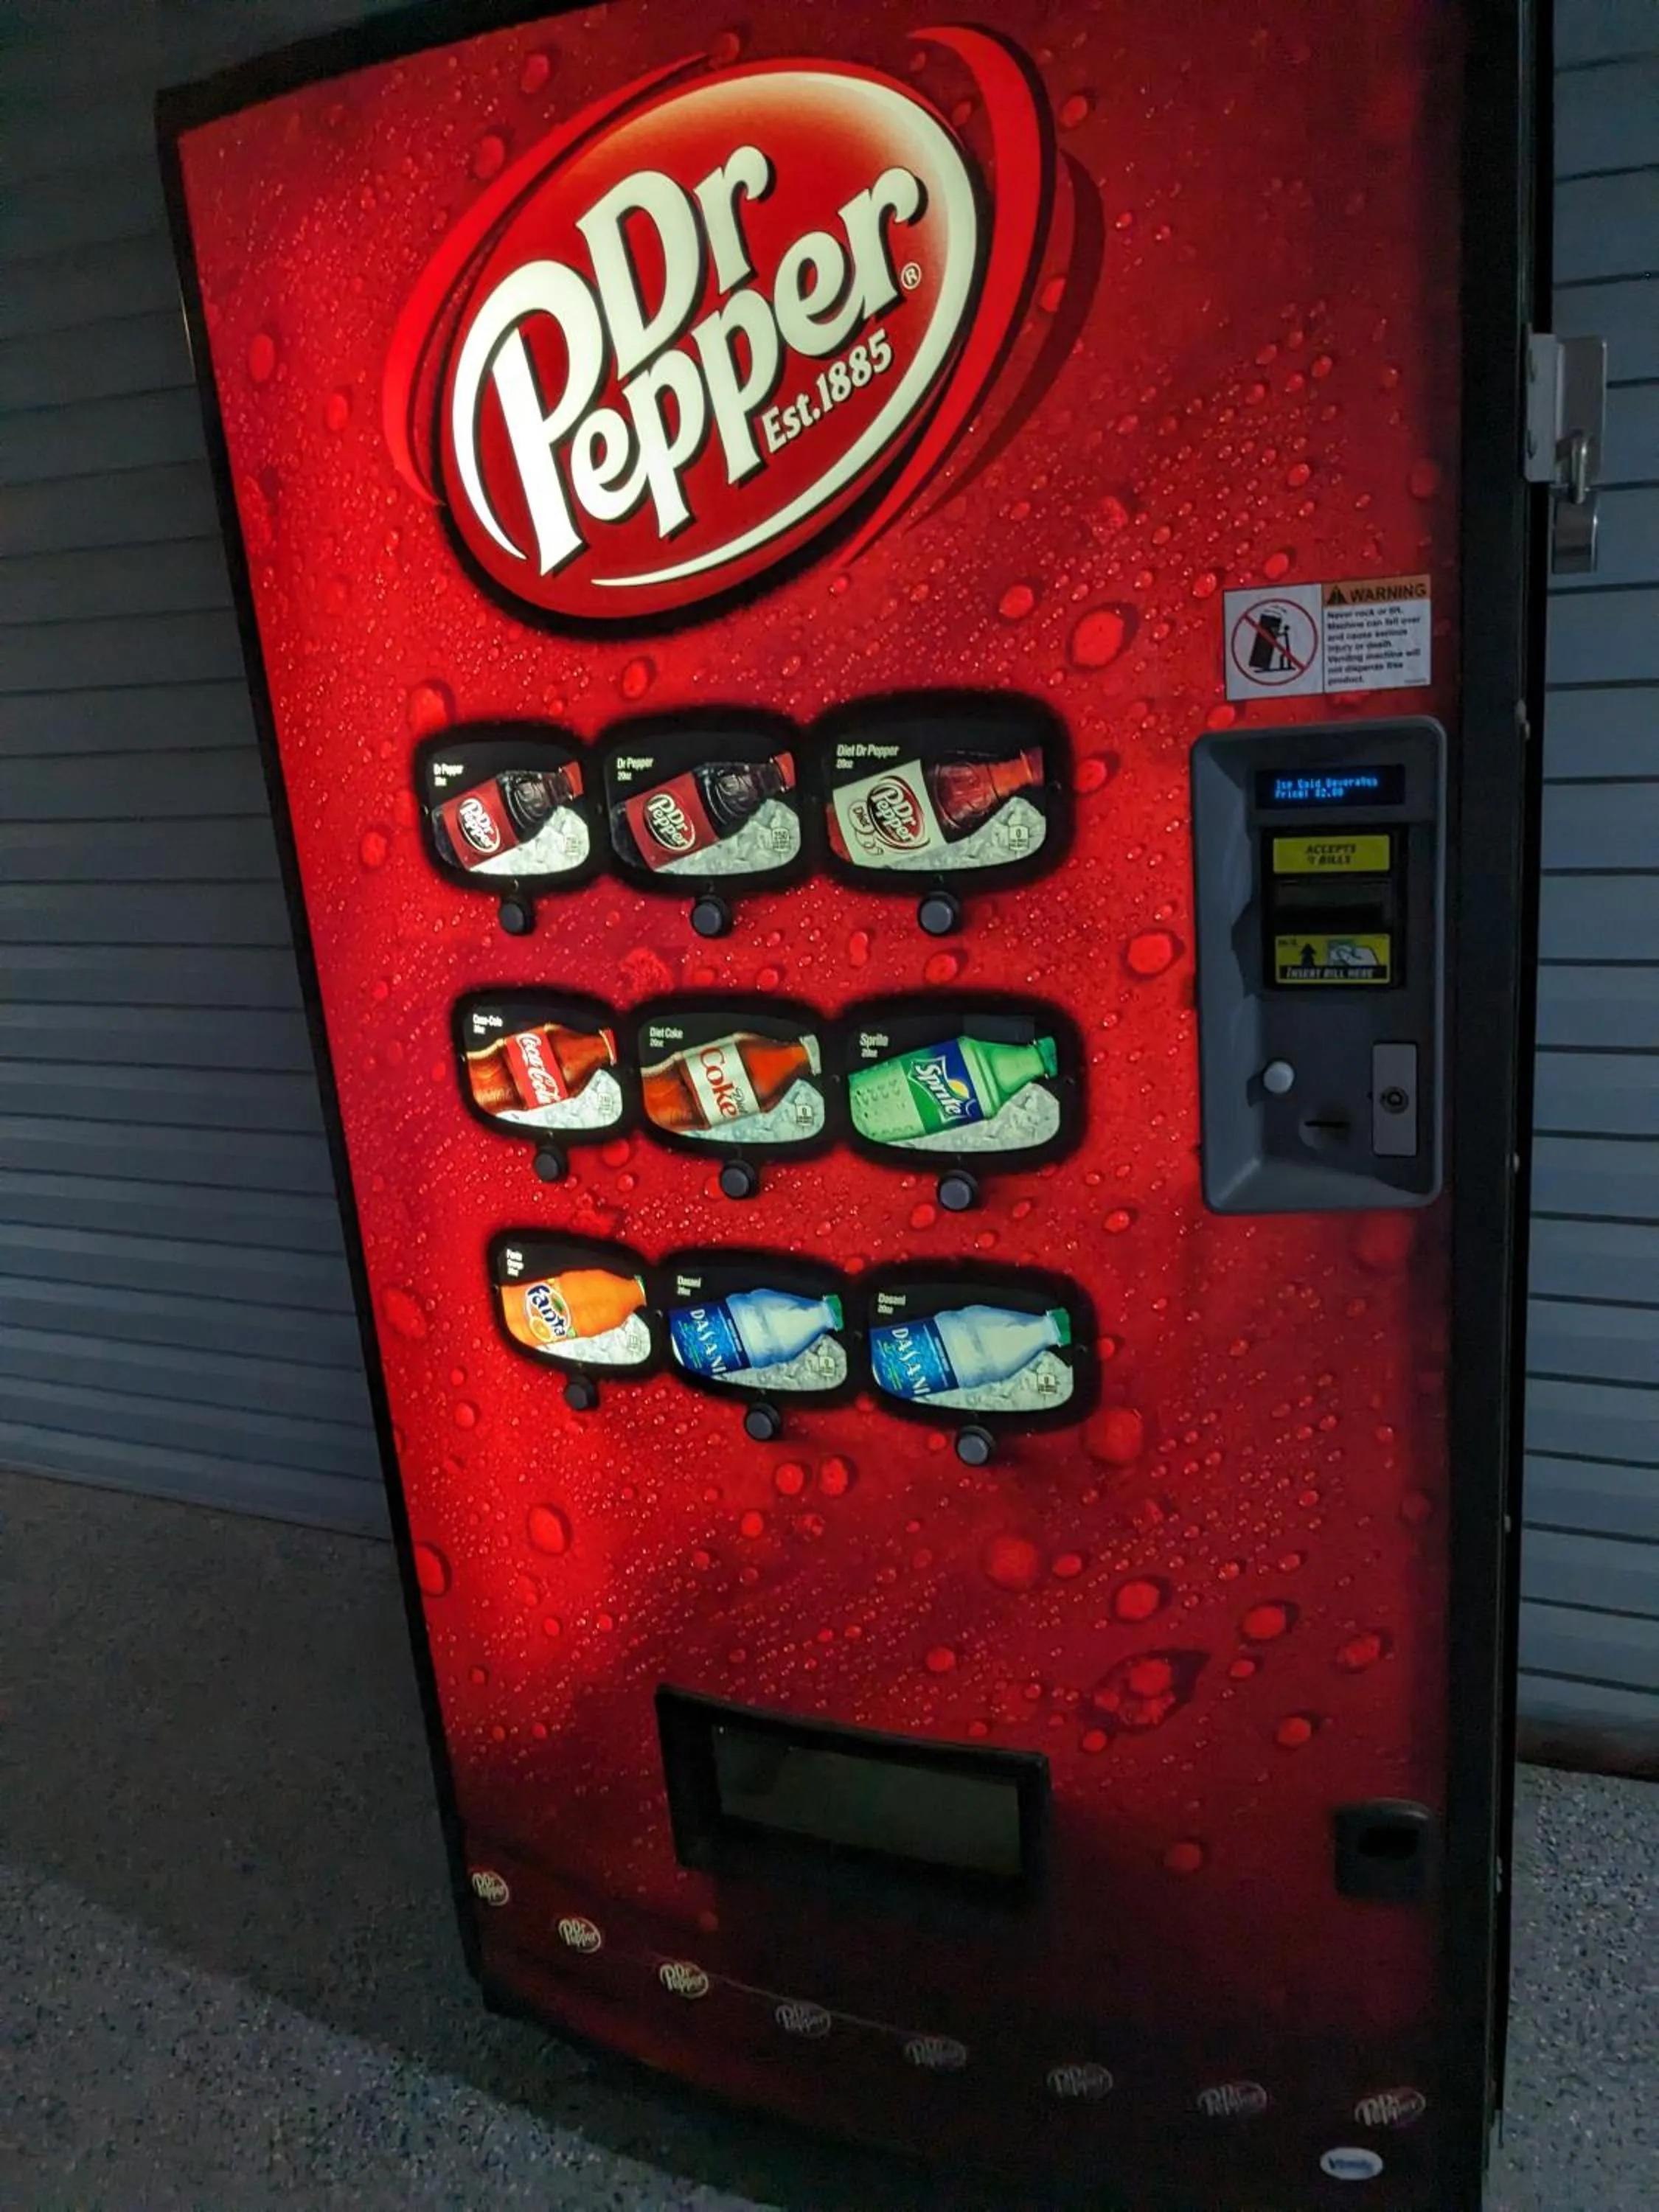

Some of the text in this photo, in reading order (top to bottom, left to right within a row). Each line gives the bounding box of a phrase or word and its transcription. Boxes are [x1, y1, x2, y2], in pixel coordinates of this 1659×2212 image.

[577, 146, 770, 380] Dr
[452, 167, 920, 576] Pepper
[1351, 582, 1426, 603] WARNING
[1328, 611, 1352, 619] Never
[1355, 608, 1374, 616] rock
[1328, 621, 1363, 630] Machine
[1385, 617, 1399, 625] fall
[1328, 629, 1408, 641] and cause serious
[1328, 644, 1352, 653] injury
[1328, 648, 1421, 664] Vending machine will
[1345, 664, 1384, 672] dispense
[836, 744, 900, 759] Diet Dr Pepper
[617, 757, 653, 771] Dr Pepper
[647, 794, 689, 846] Pepper
[669, 809, 689, 832] Dr
[870, 784, 914, 843] Pepper
[897, 802, 917, 827] Dr
[650, 1026, 684, 1040] Diet Coke
[860, 1033, 888, 1048] Sprite
[700, 1046, 737, 1119] Coke
[914, 1064, 963, 1115] Sprite
[677, 1275, 701, 1289] Dasani
[878, 1293, 905, 1306] Dasani
[527, 1284, 566, 1337] Fanta
[689, 1308, 727, 1374] DASANI
[891, 1327, 931, 1394] DASANI
